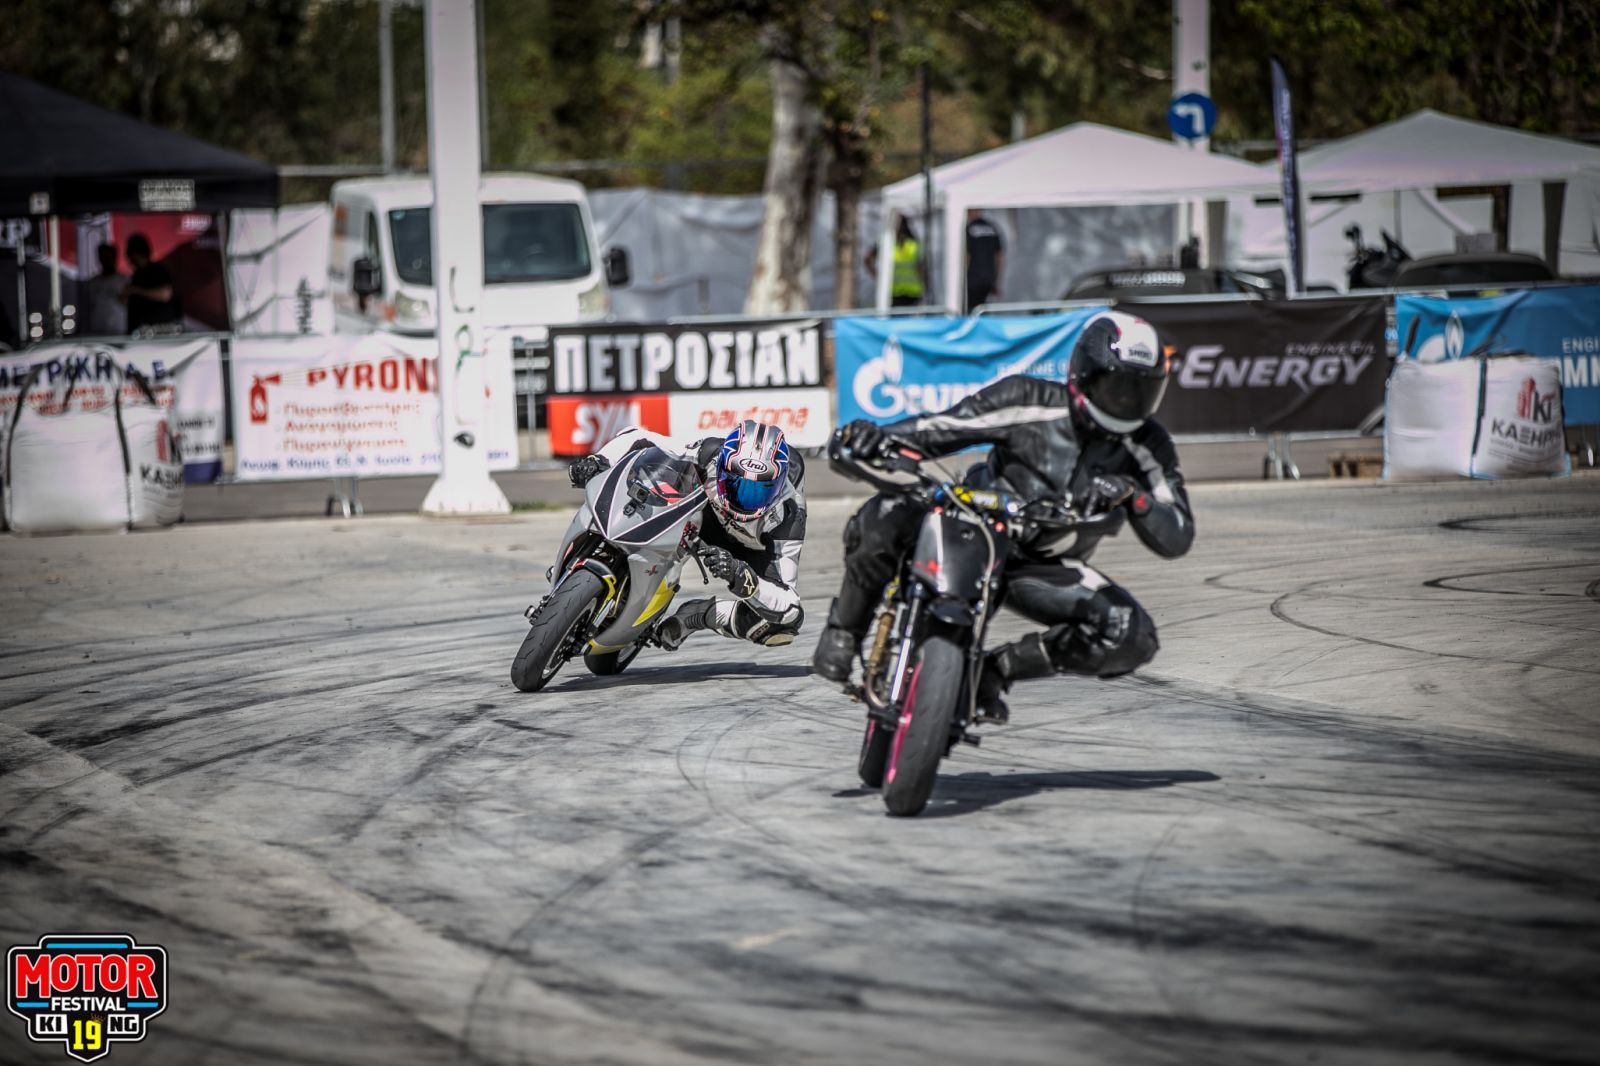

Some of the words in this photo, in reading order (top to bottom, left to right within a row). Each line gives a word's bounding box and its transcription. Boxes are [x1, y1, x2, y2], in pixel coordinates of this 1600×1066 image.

[307, 356, 439, 394] PYRON
[553, 329, 820, 393] ΠΕΤΡΟΣΙΑΝ
[742, 459, 765, 471] Arai
